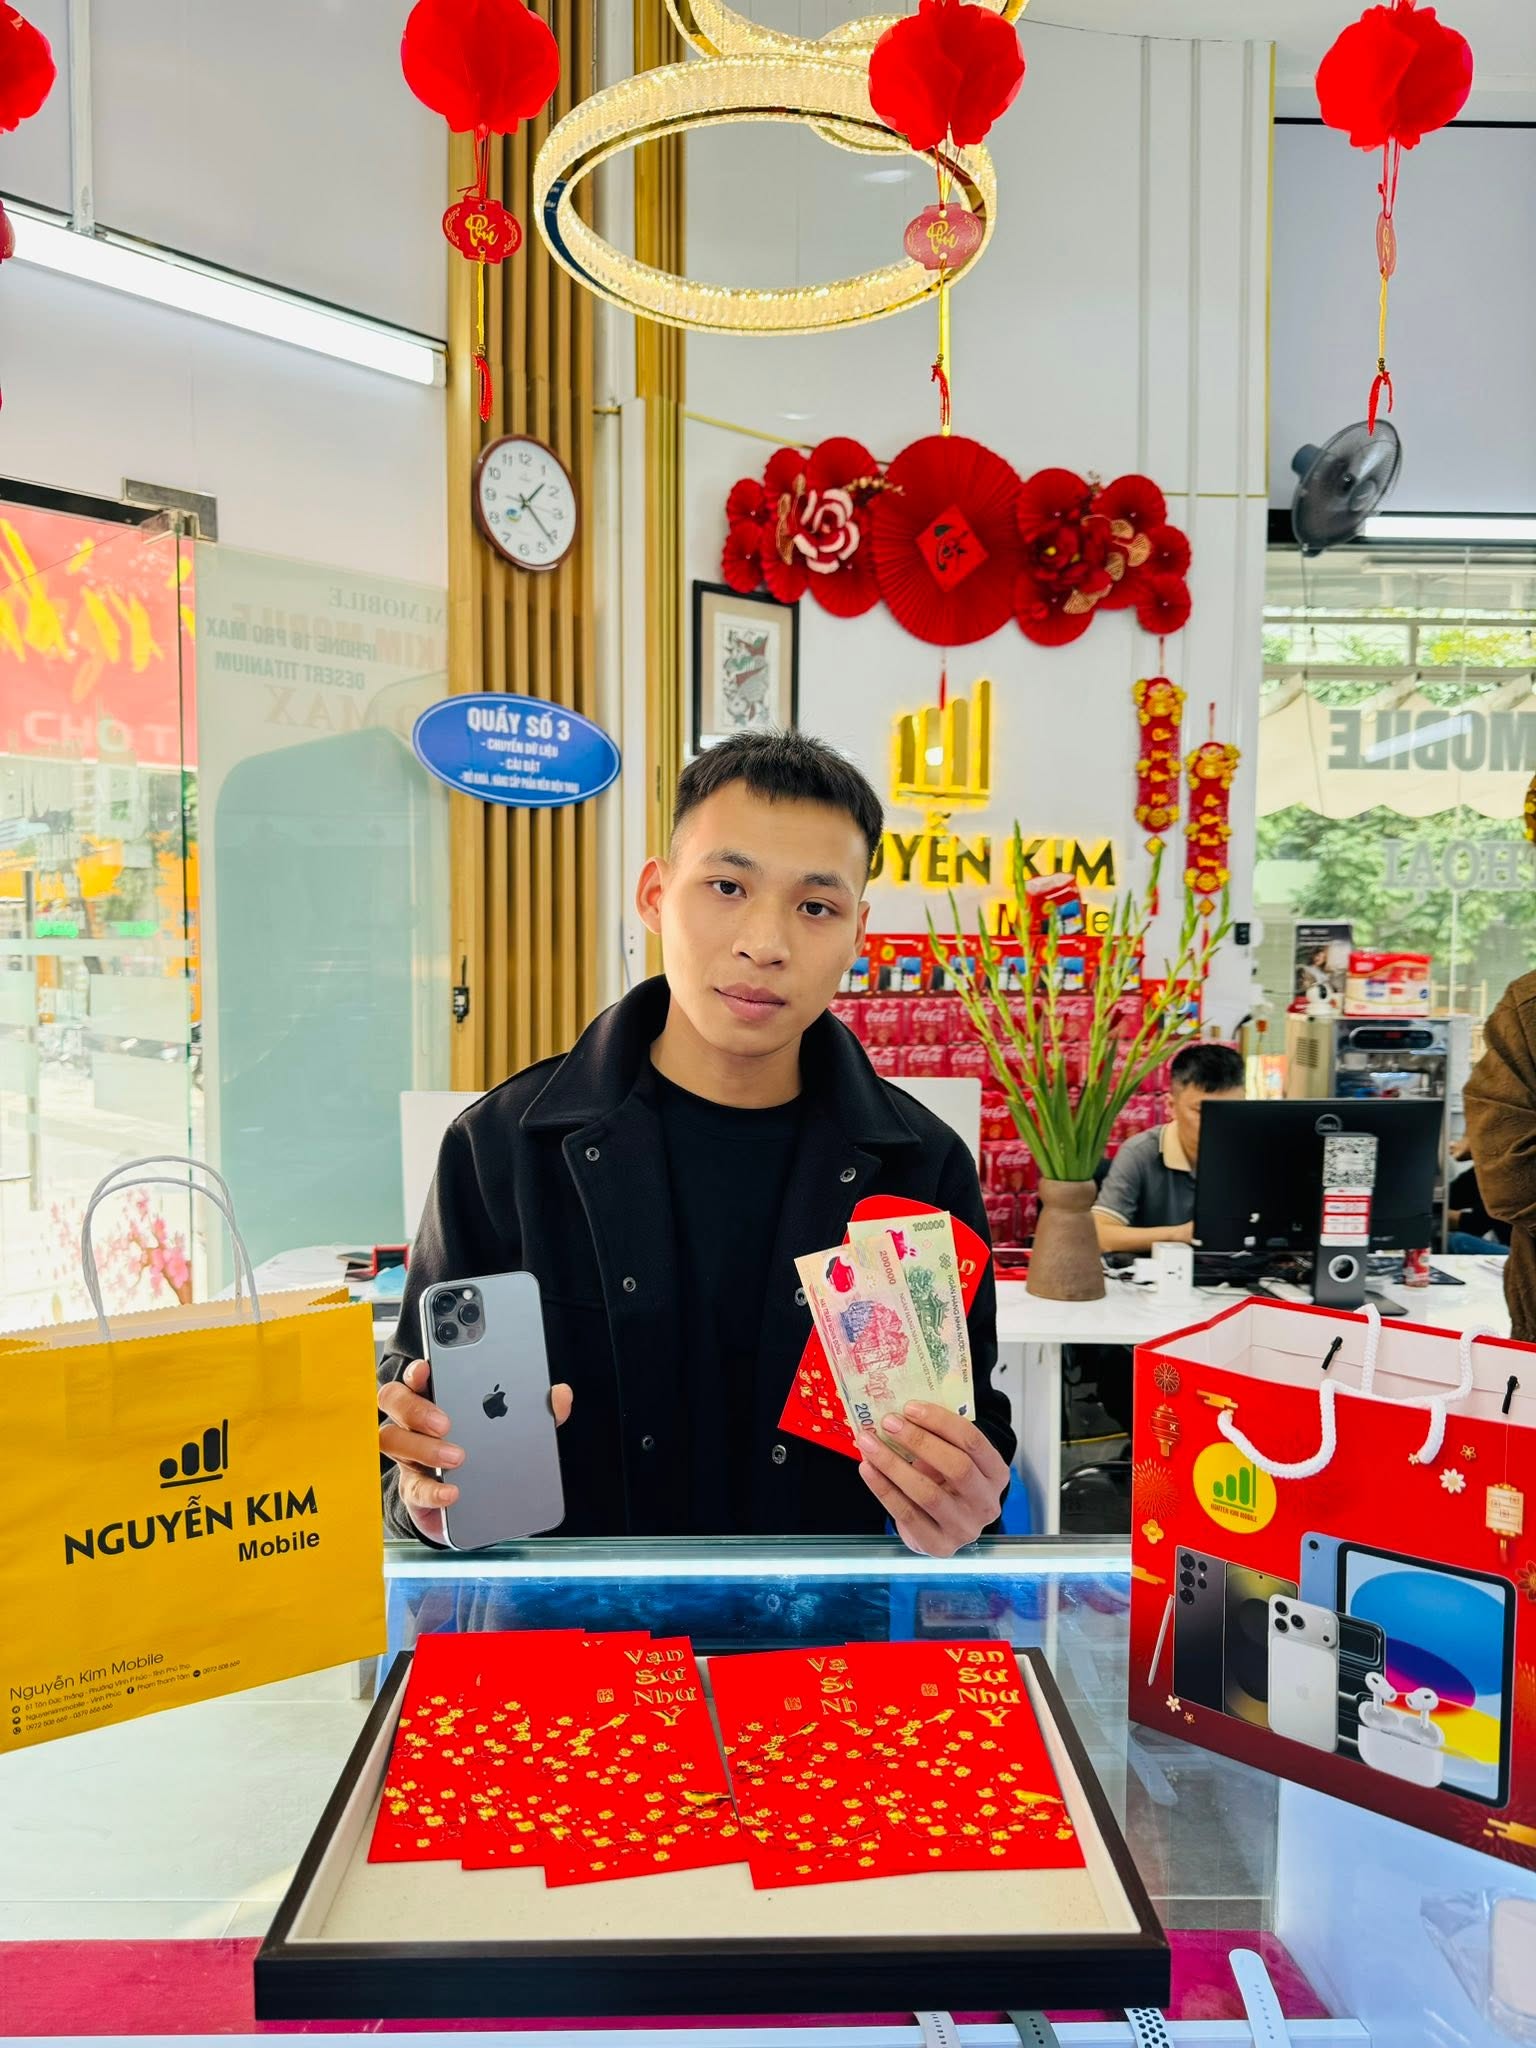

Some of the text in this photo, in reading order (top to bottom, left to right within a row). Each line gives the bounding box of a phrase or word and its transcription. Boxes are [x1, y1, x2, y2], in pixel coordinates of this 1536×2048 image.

[502, 454, 513, 467] 11
[519, 453, 532, 466] 12
[488, 467, 502, 480] 10
[485, 487, 497, 501] 9
[549, 486, 559, 497] 2
[489, 512, 500, 524] 8
[554, 508, 564, 520] 3
[502, 532, 512, 543] 7
[520, 543, 530, 556] 6
[537, 542, 547, 553] 5
[525, 711, 553, 739] SỐ
[557, 720, 570, 741] 3
[869, 811, 1116, 886] UYỄN KIM
[960, 1368, 969, 1383] NAM
[64, 1486, 319, 1565] NGUYỄN KIM
[238, 1530, 320, 1562] Mobile
[623, 1648, 685, 1666] Vạn
[807, 1656, 848, 1673] Vạ
[944, 1647, 1005, 1665] Vạn
[9, 1652, 164, 1701] Nguyễn Kim Mobile
[635, 1666, 688, 1685] Sự
[957, 1667, 1009, 1686] Sự
[820, 1676, 853, 1694] S
[632, 1687, 698, 1706] Như
[956, 1687, 1022, 1705] Như
[820, 1696, 858, 1715] Nh
[649, 1705, 685, 1727] Ý
[976, 1706, 1011, 1727] Ý
